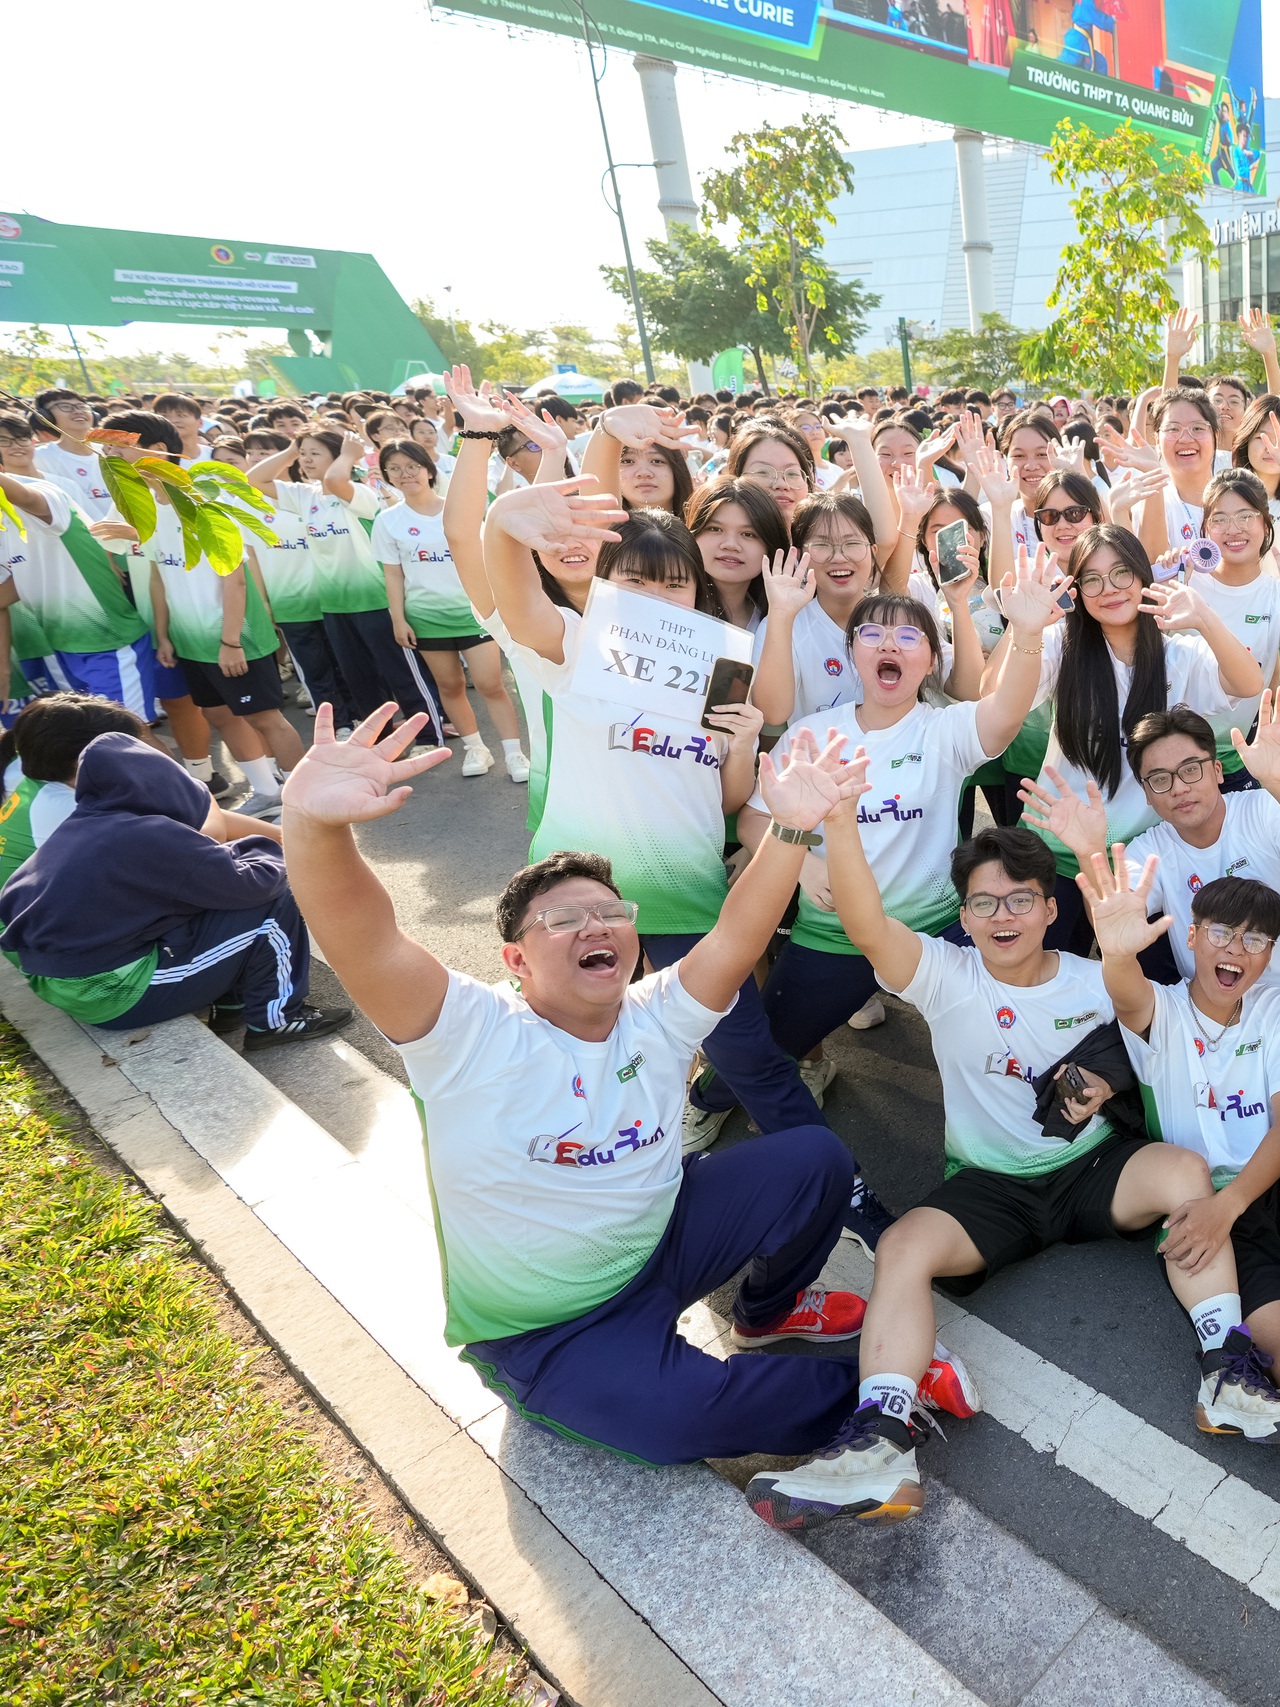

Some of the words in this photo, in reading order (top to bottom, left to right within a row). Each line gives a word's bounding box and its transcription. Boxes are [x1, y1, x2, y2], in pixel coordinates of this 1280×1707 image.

[734, 0, 794, 27] CURIE
[1026, 66, 1080, 95] TRƯỜNG
[1081, 83, 1114, 104] THPT
[1114, 93, 1130, 112] TẠ
[1131, 98, 1170, 120] QUANG
[1172, 108, 1194, 127] BỬU
[610, 624, 652, 645] PHAN
[656, 635, 699, 658] ĐĂNG
[660, 619, 696, 639] THPT
[603, 648, 656, 683] XE
[664, 665, 711, 697] 22
[856, 794, 922, 823] duRun
[1197, 1318, 1221, 1341] 16
[880, 1391, 906, 1414] 16
